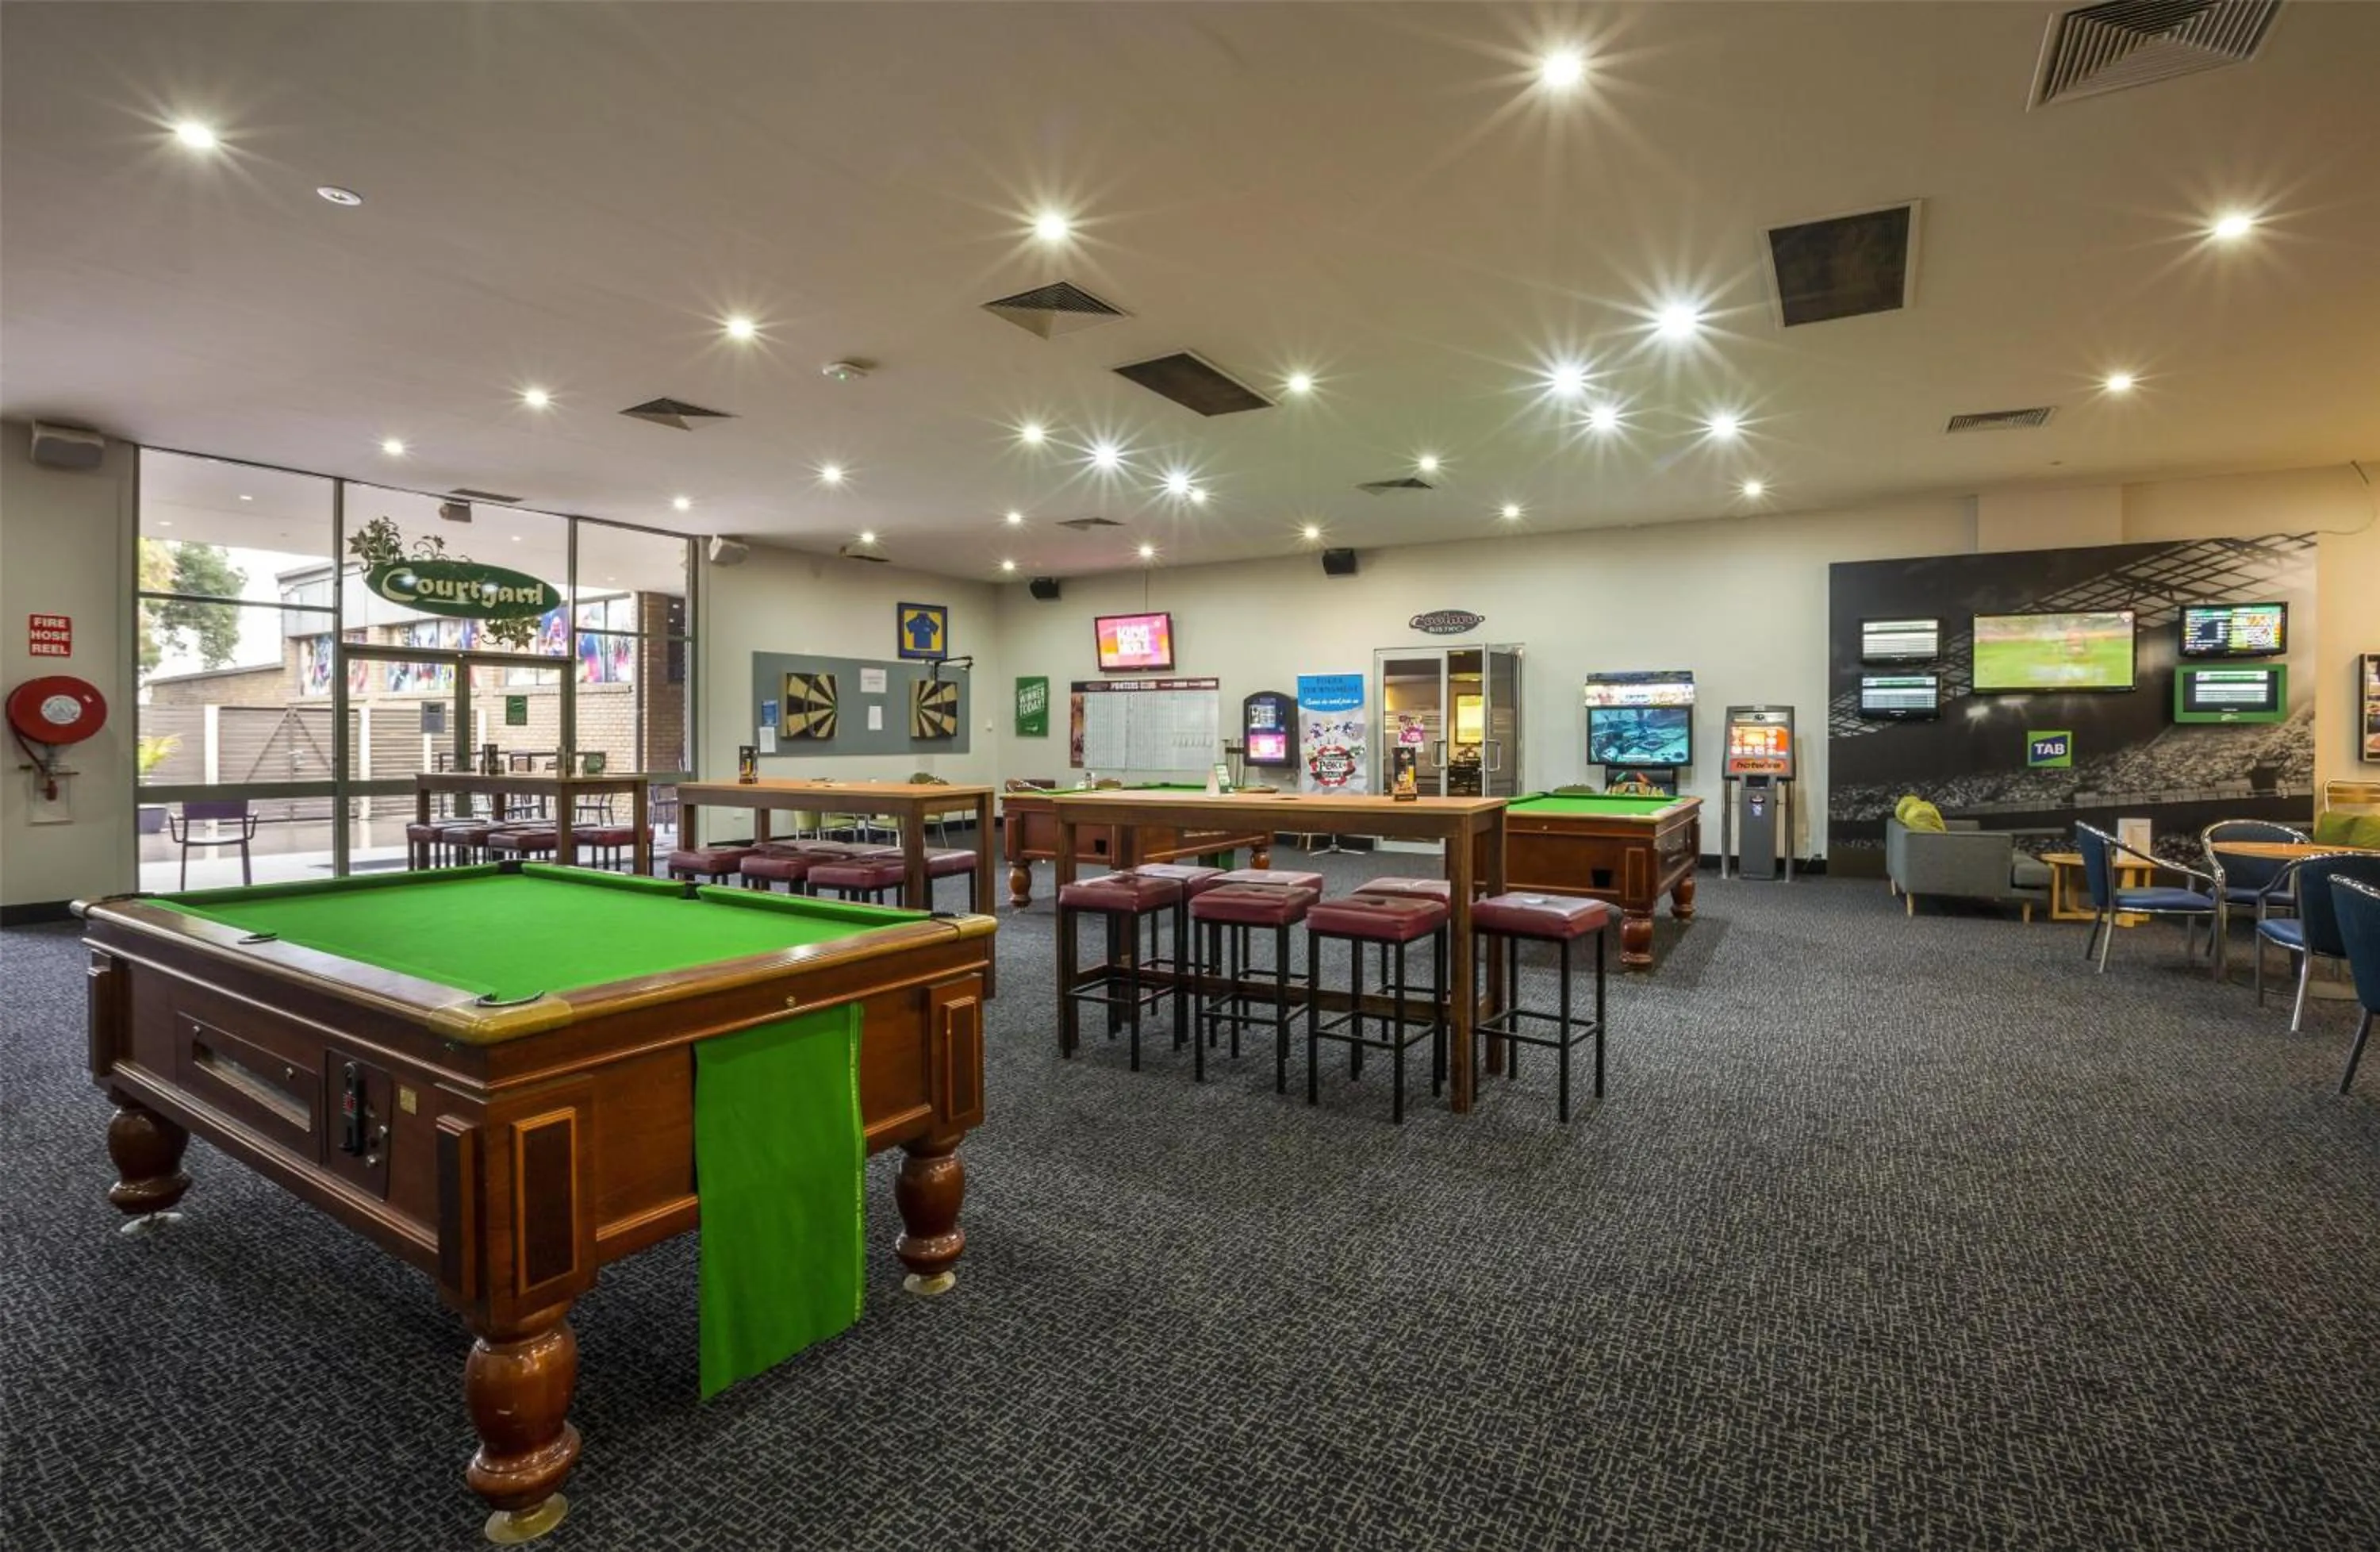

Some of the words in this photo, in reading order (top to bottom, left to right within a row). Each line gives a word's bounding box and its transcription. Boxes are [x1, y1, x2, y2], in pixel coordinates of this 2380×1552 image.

[382, 567, 543, 609] Courtyard
[33, 617, 66, 628] FIRE
[31, 630, 70, 641] HOSE
[32, 643, 69, 655] REEL
[1019, 686, 1045, 705] WINNER
[2034, 743, 2065, 755] TAB
